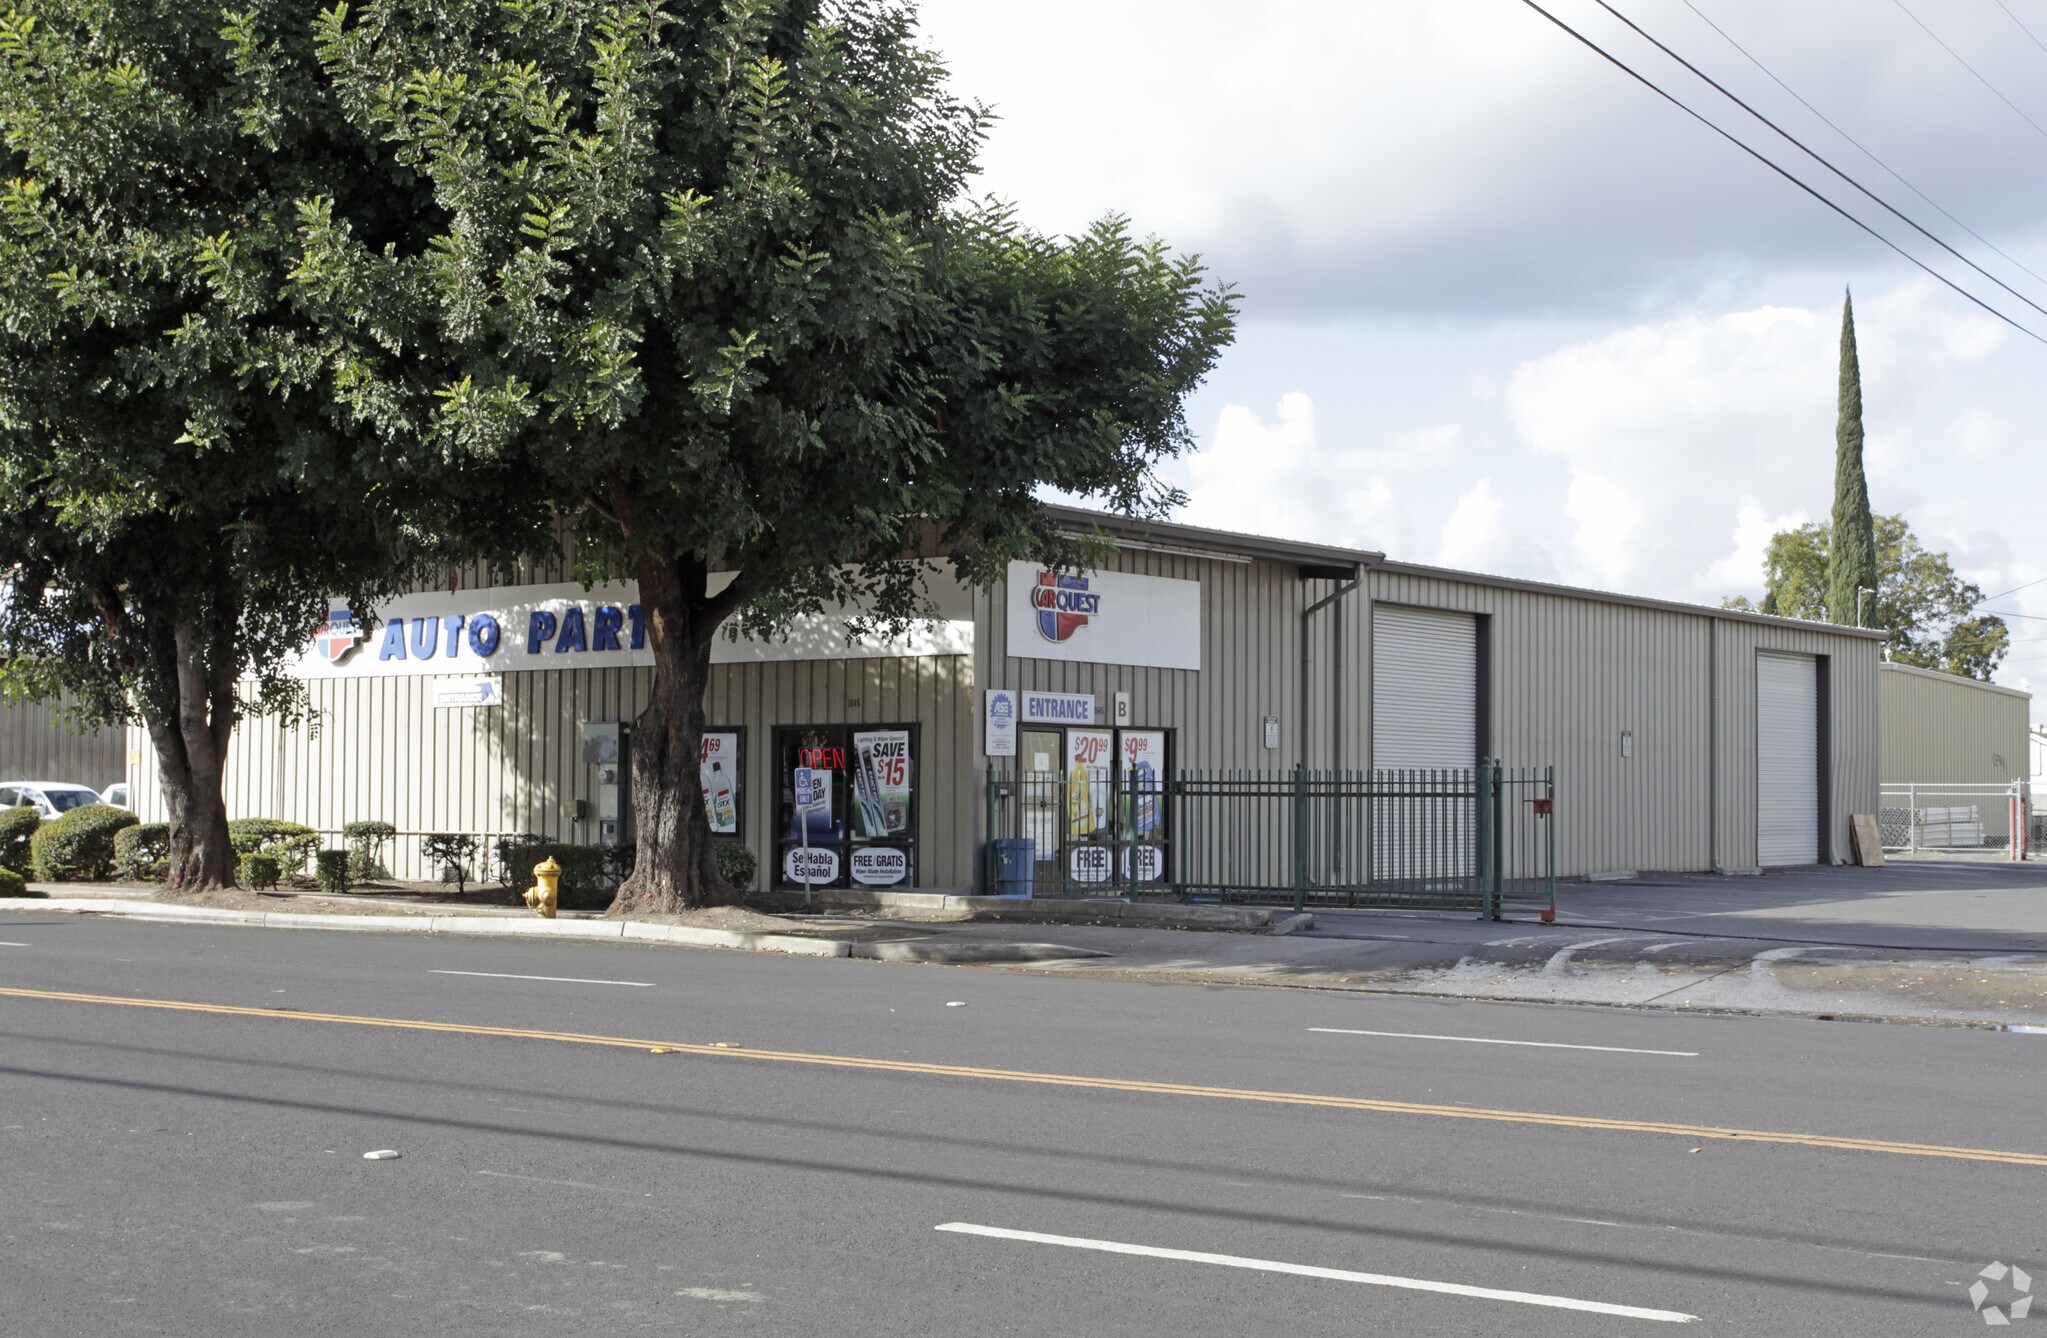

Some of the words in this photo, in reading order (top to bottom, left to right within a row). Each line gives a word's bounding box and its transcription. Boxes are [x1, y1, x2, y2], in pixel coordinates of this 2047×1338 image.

[1036, 587, 1101, 613] CARQUEST
[379, 613, 501, 661] AUTO
[527, 604, 646, 654] PART
[994, 701, 1009, 713] ASE
[1029, 697, 1088, 719] ENTRANCE
[1118, 701, 1127, 717] B
[799, 747, 845, 769] OPEN
[873, 742, 905, 758] SAVE
[792, 851, 804, 863] Se
[807, 853, 833, 865] Habla
[853, 855, 903, 867] FREE/GRATIS
[1077, 850, 1105, 868] FREE
